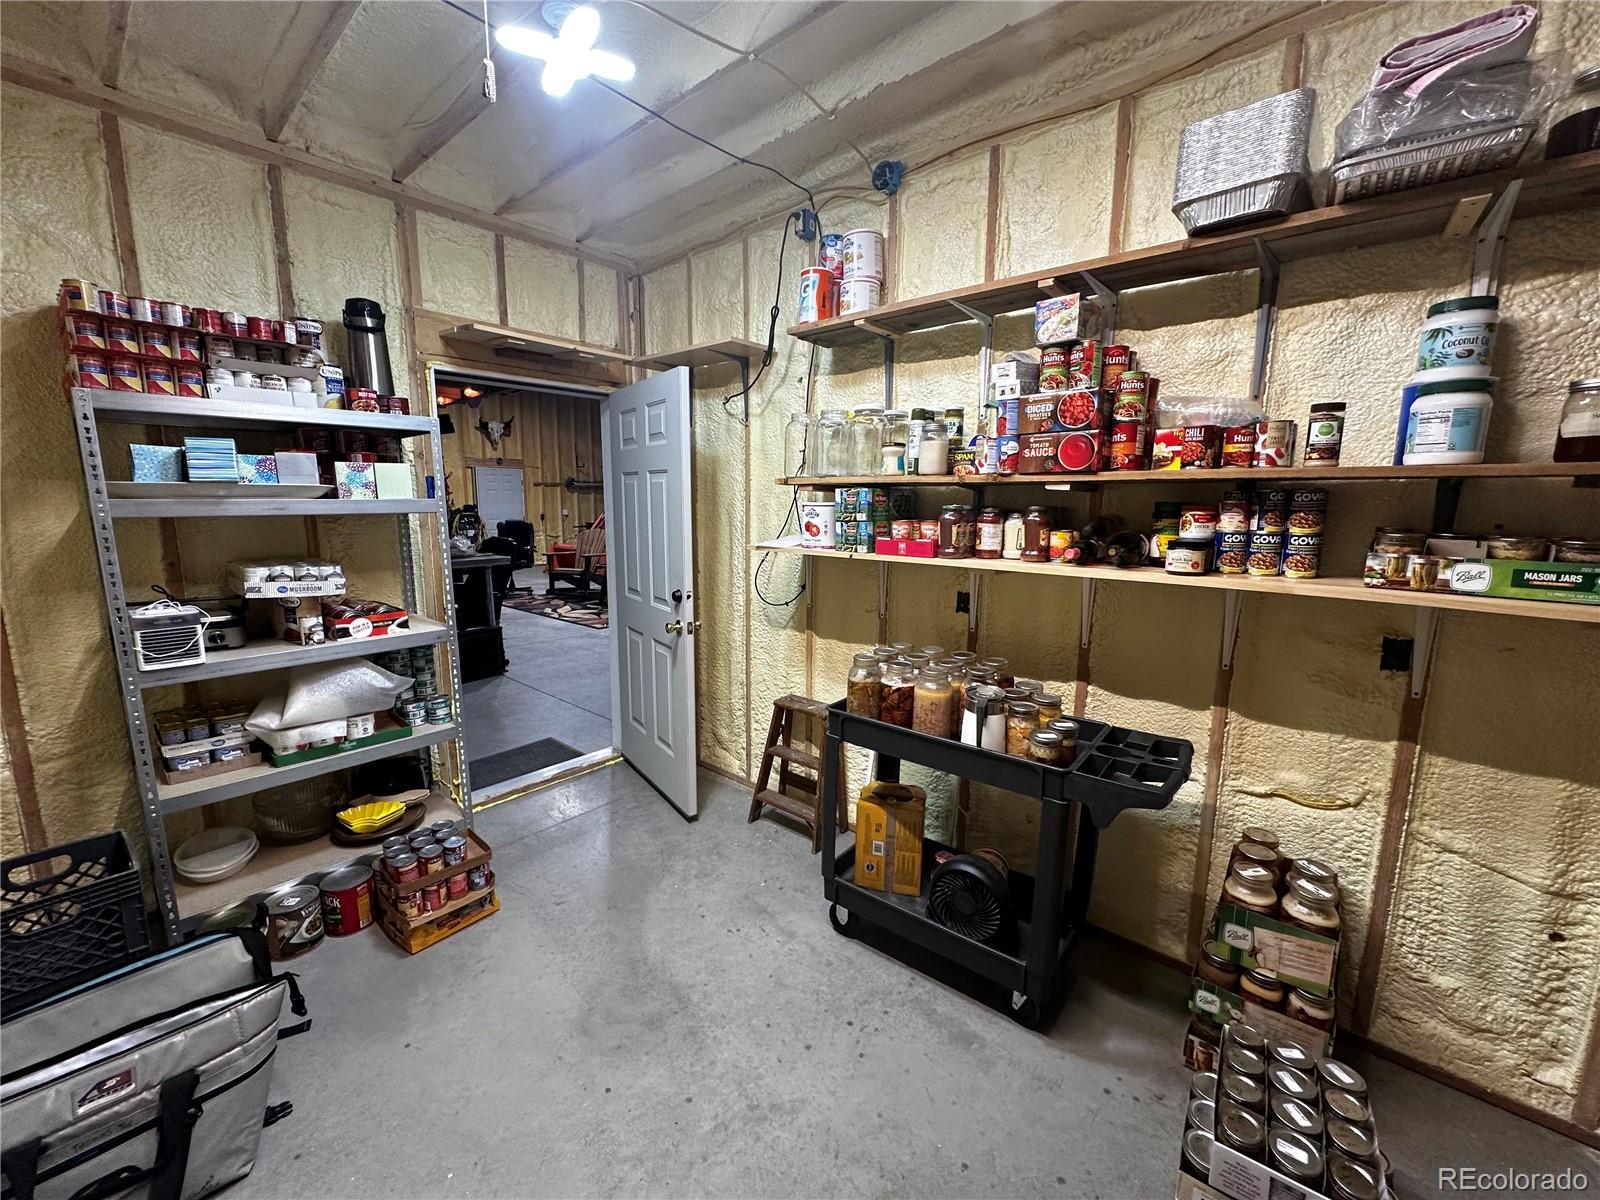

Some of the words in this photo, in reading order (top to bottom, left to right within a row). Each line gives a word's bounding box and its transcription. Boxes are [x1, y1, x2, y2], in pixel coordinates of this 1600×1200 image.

[1442, 336, 1479, 350] Coconut
[1027, 403, 1053, 414] DICED
[1185, 427, 1205, 438] CHILI
[954, 453, 974, 461] SPAM
[1024, 447, 1054, 458] SAUCE
[1455, 570, 1487, 583] Ball
[1524, 572, 1556, 581] MASON
[1558, 574, 1583, 583] JARS
[1226, 929, 1249, 942] Ball
